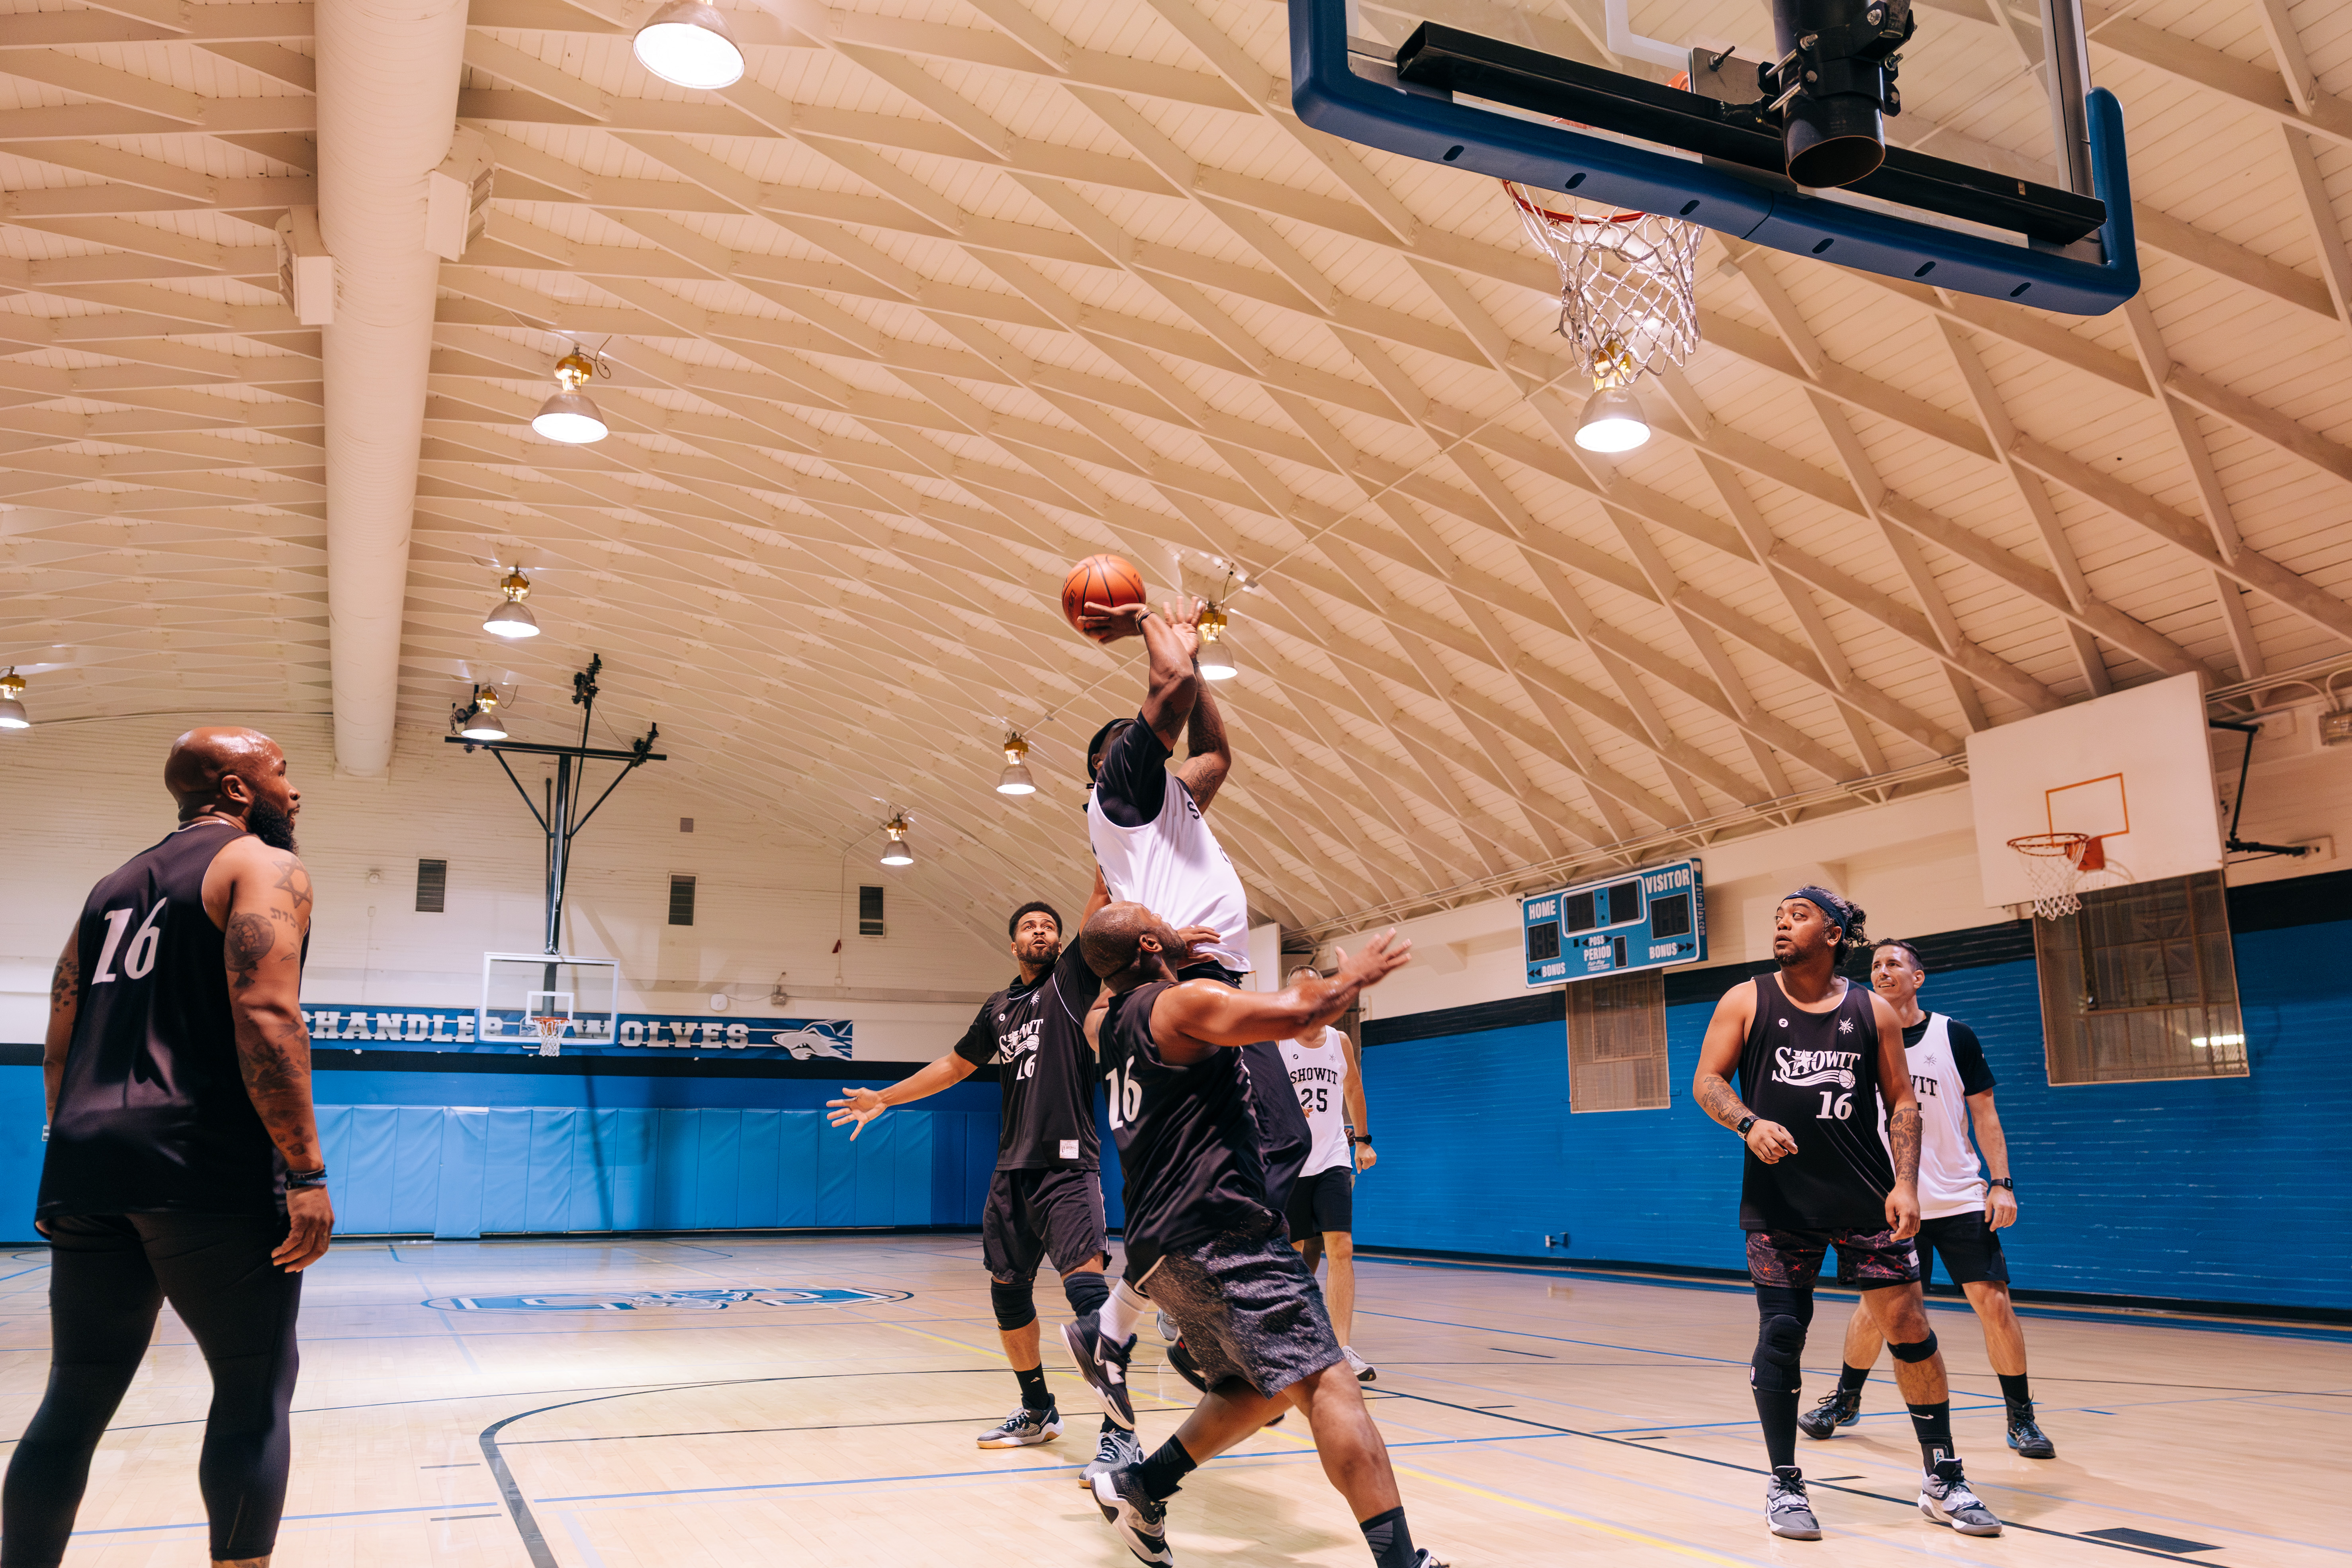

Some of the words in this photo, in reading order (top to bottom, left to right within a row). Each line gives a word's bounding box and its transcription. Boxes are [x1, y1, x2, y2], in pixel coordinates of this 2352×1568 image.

[1645, 868, 1691, 894] VISITOR
[1528, 899, 1556, 920] HOME
[91, 897, 167, 985] 16
[1589, 935, 1605, 946] POSS
[1649, 942, 1678, 959] BONUS
[1583, 945, 1611, 962] PERIOD
[1541, 962, 1566, 978] BONUS
[1773, 1046, 1861, 1081] SHOWIT
[1289, 1067, 1338, 1085] SHOWIT
[1105, 1055, 1142, 1131] 16
[1301, 1088, 1328, 1112] 25
[1816, 1091, 1852, 1120] 16
